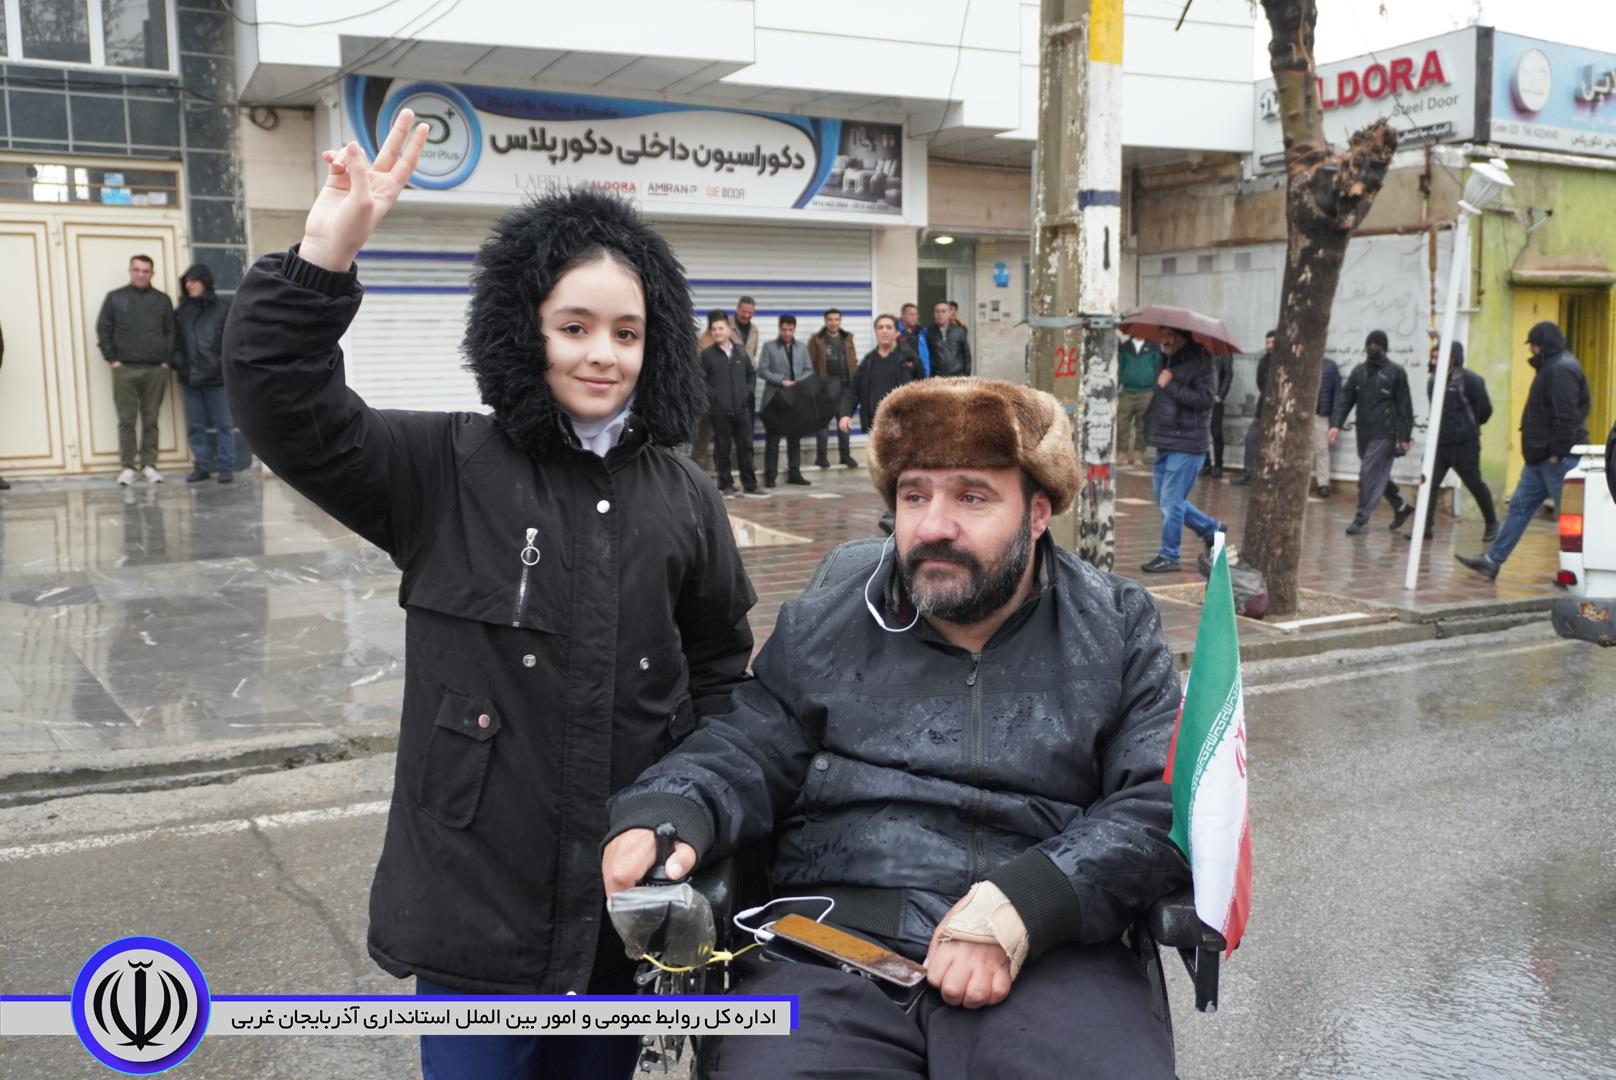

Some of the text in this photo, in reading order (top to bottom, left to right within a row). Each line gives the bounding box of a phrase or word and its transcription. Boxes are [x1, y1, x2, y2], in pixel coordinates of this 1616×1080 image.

[1316, 50, 1446, 112] LDORA
[1392, 95, 1459, 117] Steel Door
[437, 149, 460, 162] Plus
[616, 132, 690, 165] داخلی
[693, 144, 805, 176] دکوراسیون
